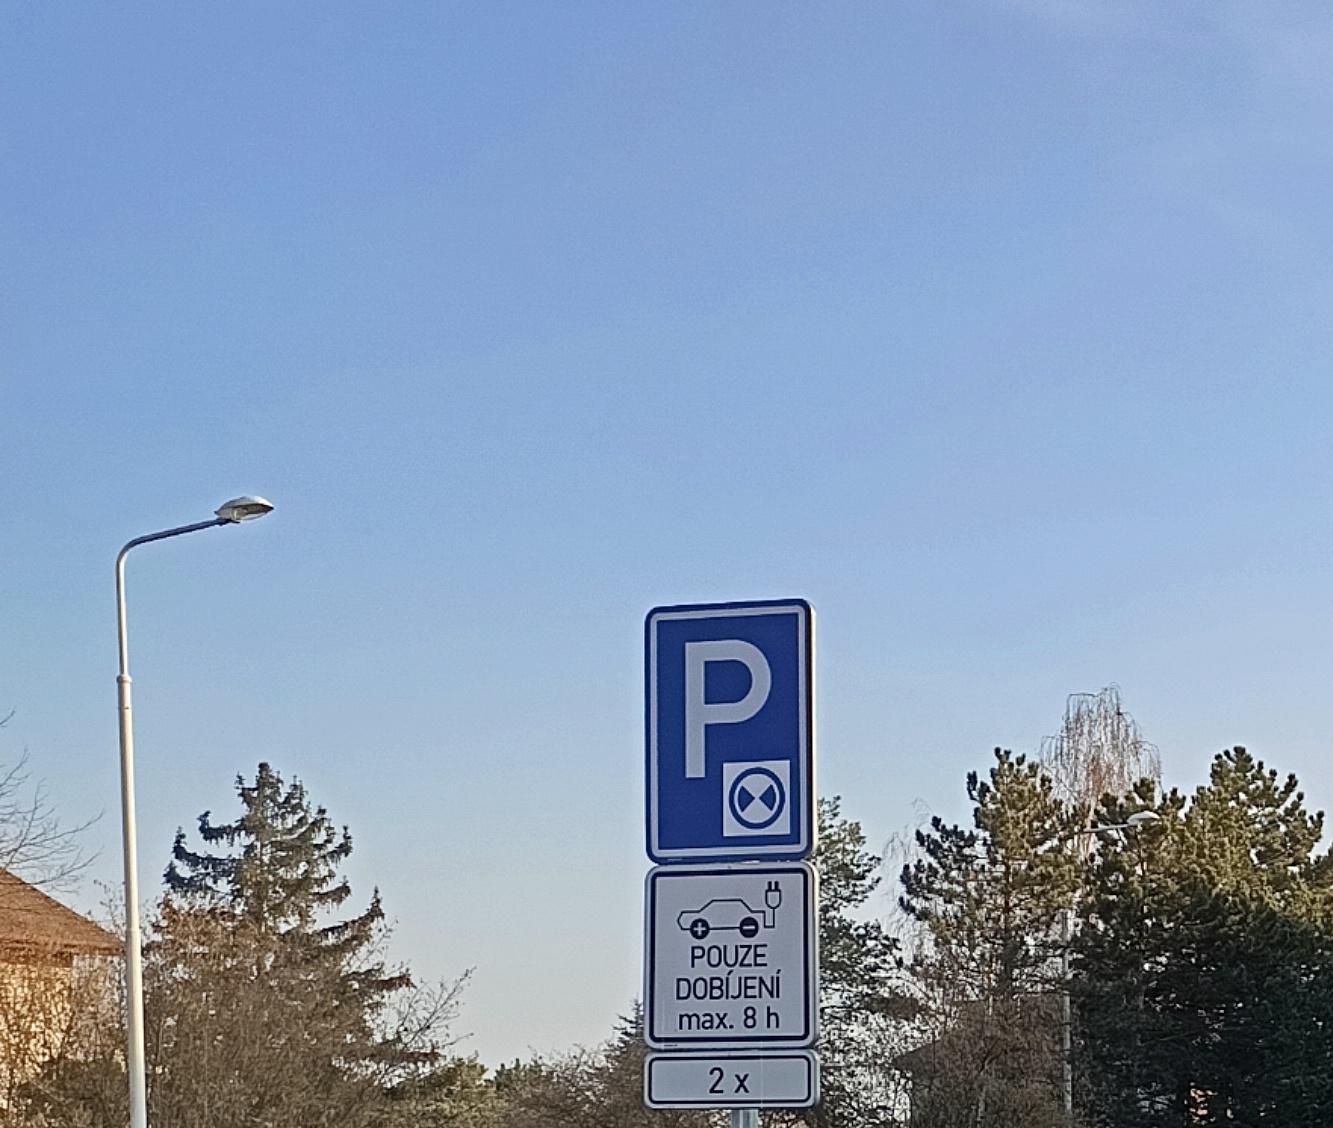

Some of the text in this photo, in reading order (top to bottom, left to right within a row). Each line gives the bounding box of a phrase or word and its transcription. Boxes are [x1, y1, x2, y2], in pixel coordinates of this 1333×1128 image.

[684, 639, 772, 779] P
[690, 943, 769, 969] POUZE
[675, 968, 782, 1001] DOBÍJENÍ
[678, 1005, 780, 1031] max. 8 h
[708, 1066, 750, 1094] 2 x
